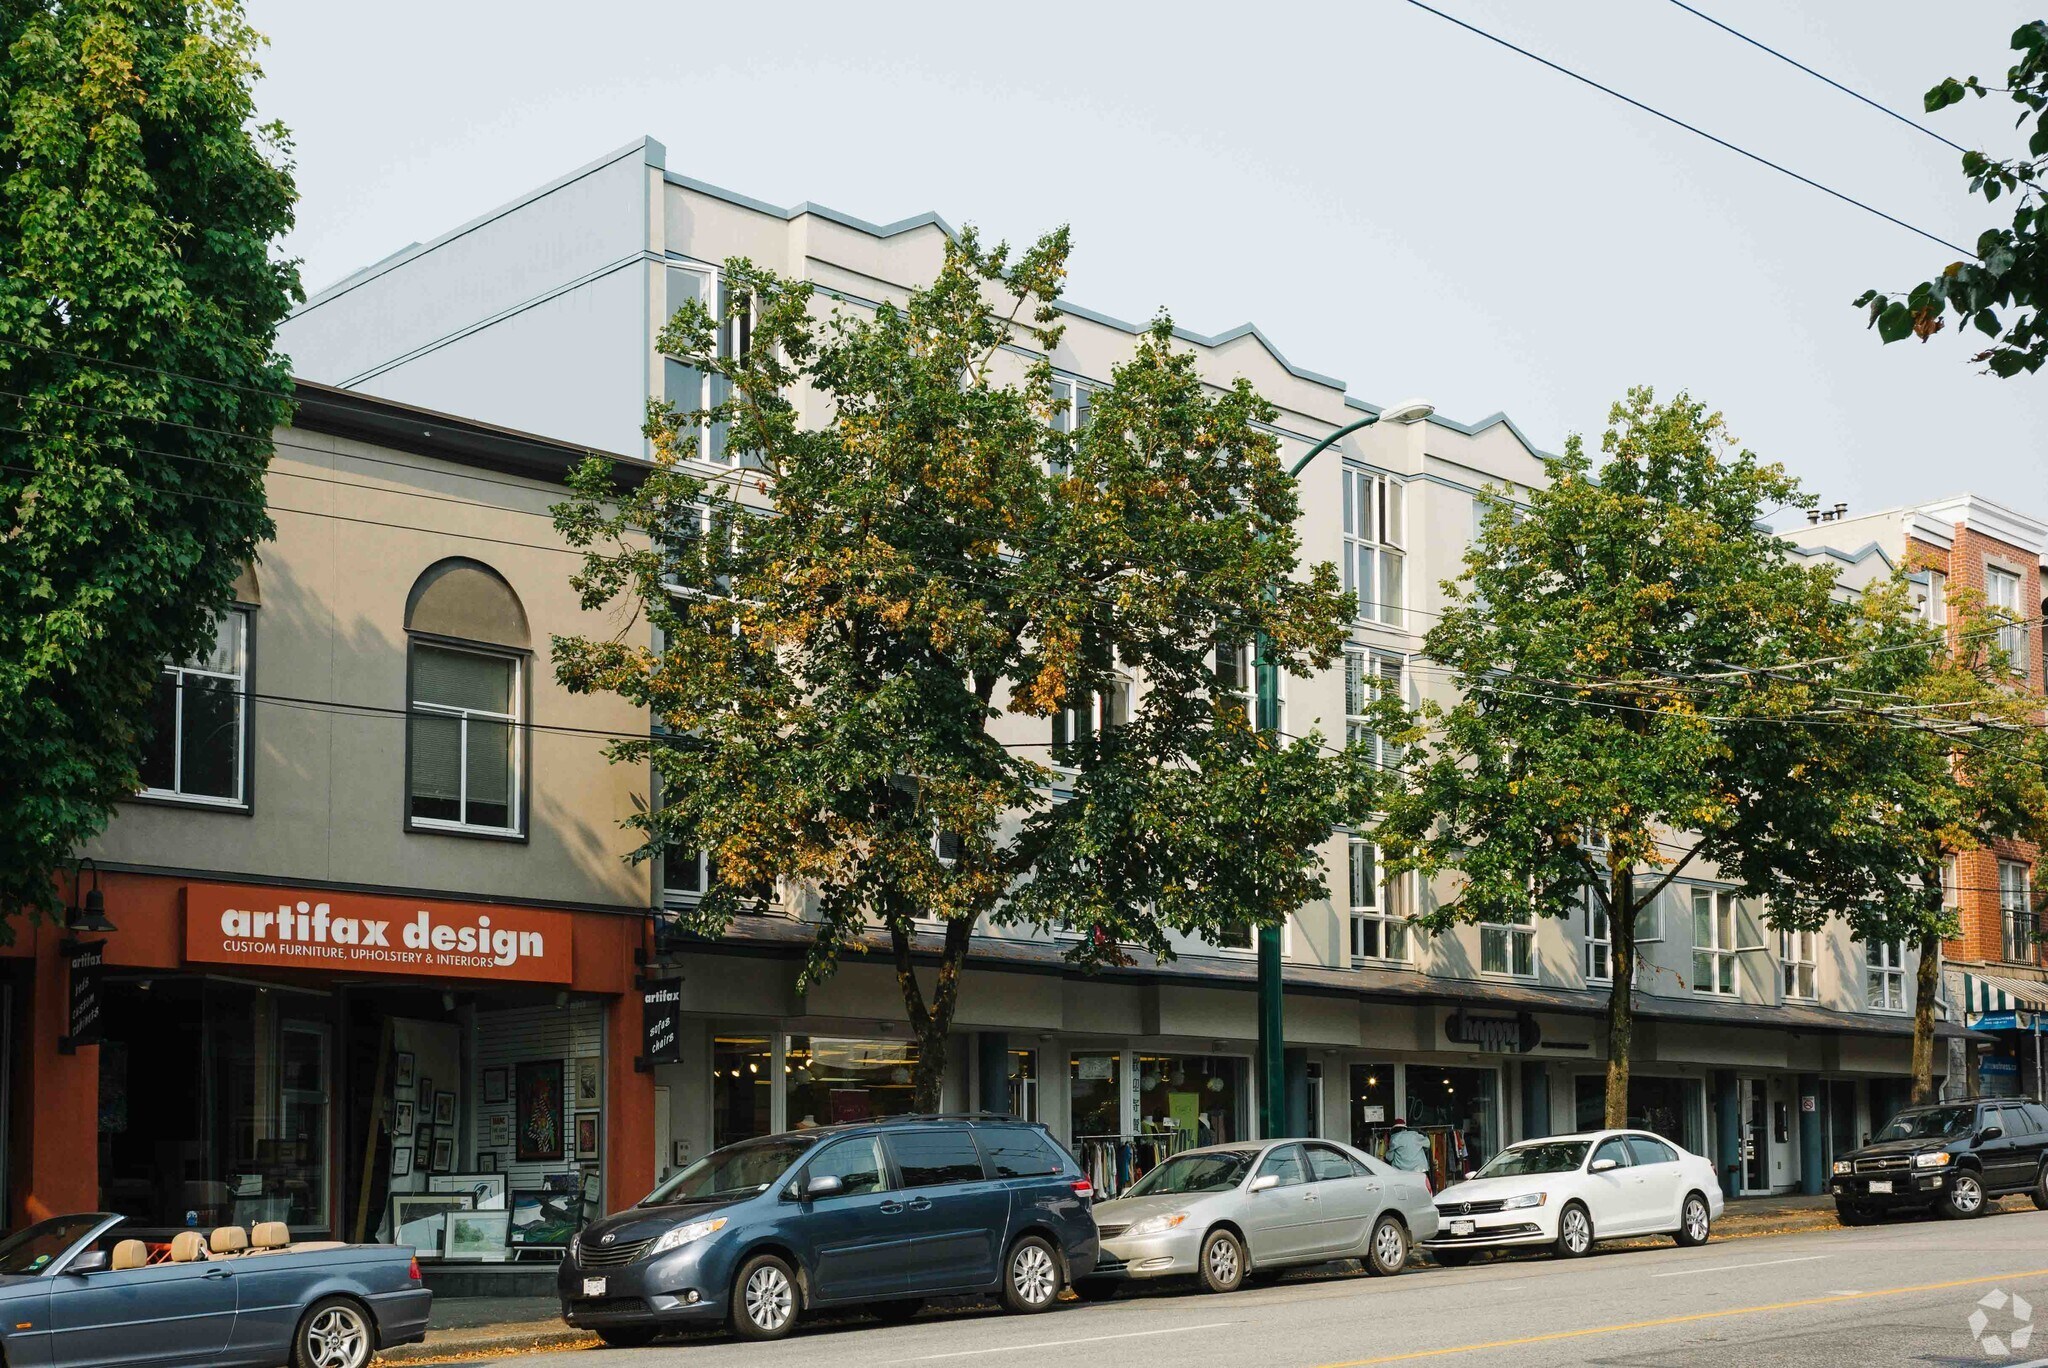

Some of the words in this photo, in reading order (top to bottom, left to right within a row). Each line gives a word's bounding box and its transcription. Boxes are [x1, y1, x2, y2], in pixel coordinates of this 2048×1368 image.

[220, 901, 391, 947] artifax
[402, 910, 544, 967] design
[72, 952, 102, 968] artifax
[222, 940, 276, 954] CUSTOM
[279, 943, 348, 960] FURNITURE,
[350, 949, 422, 964] UPHOLSTERY
[425, 953, 434, 964] &
[436, 954, 494, 968] INTERIORS
[644, 989, 680, 1004] artifax
[649, 1016, 671, 1037] sofas
[651, 1032, 675, 1054] chairs
